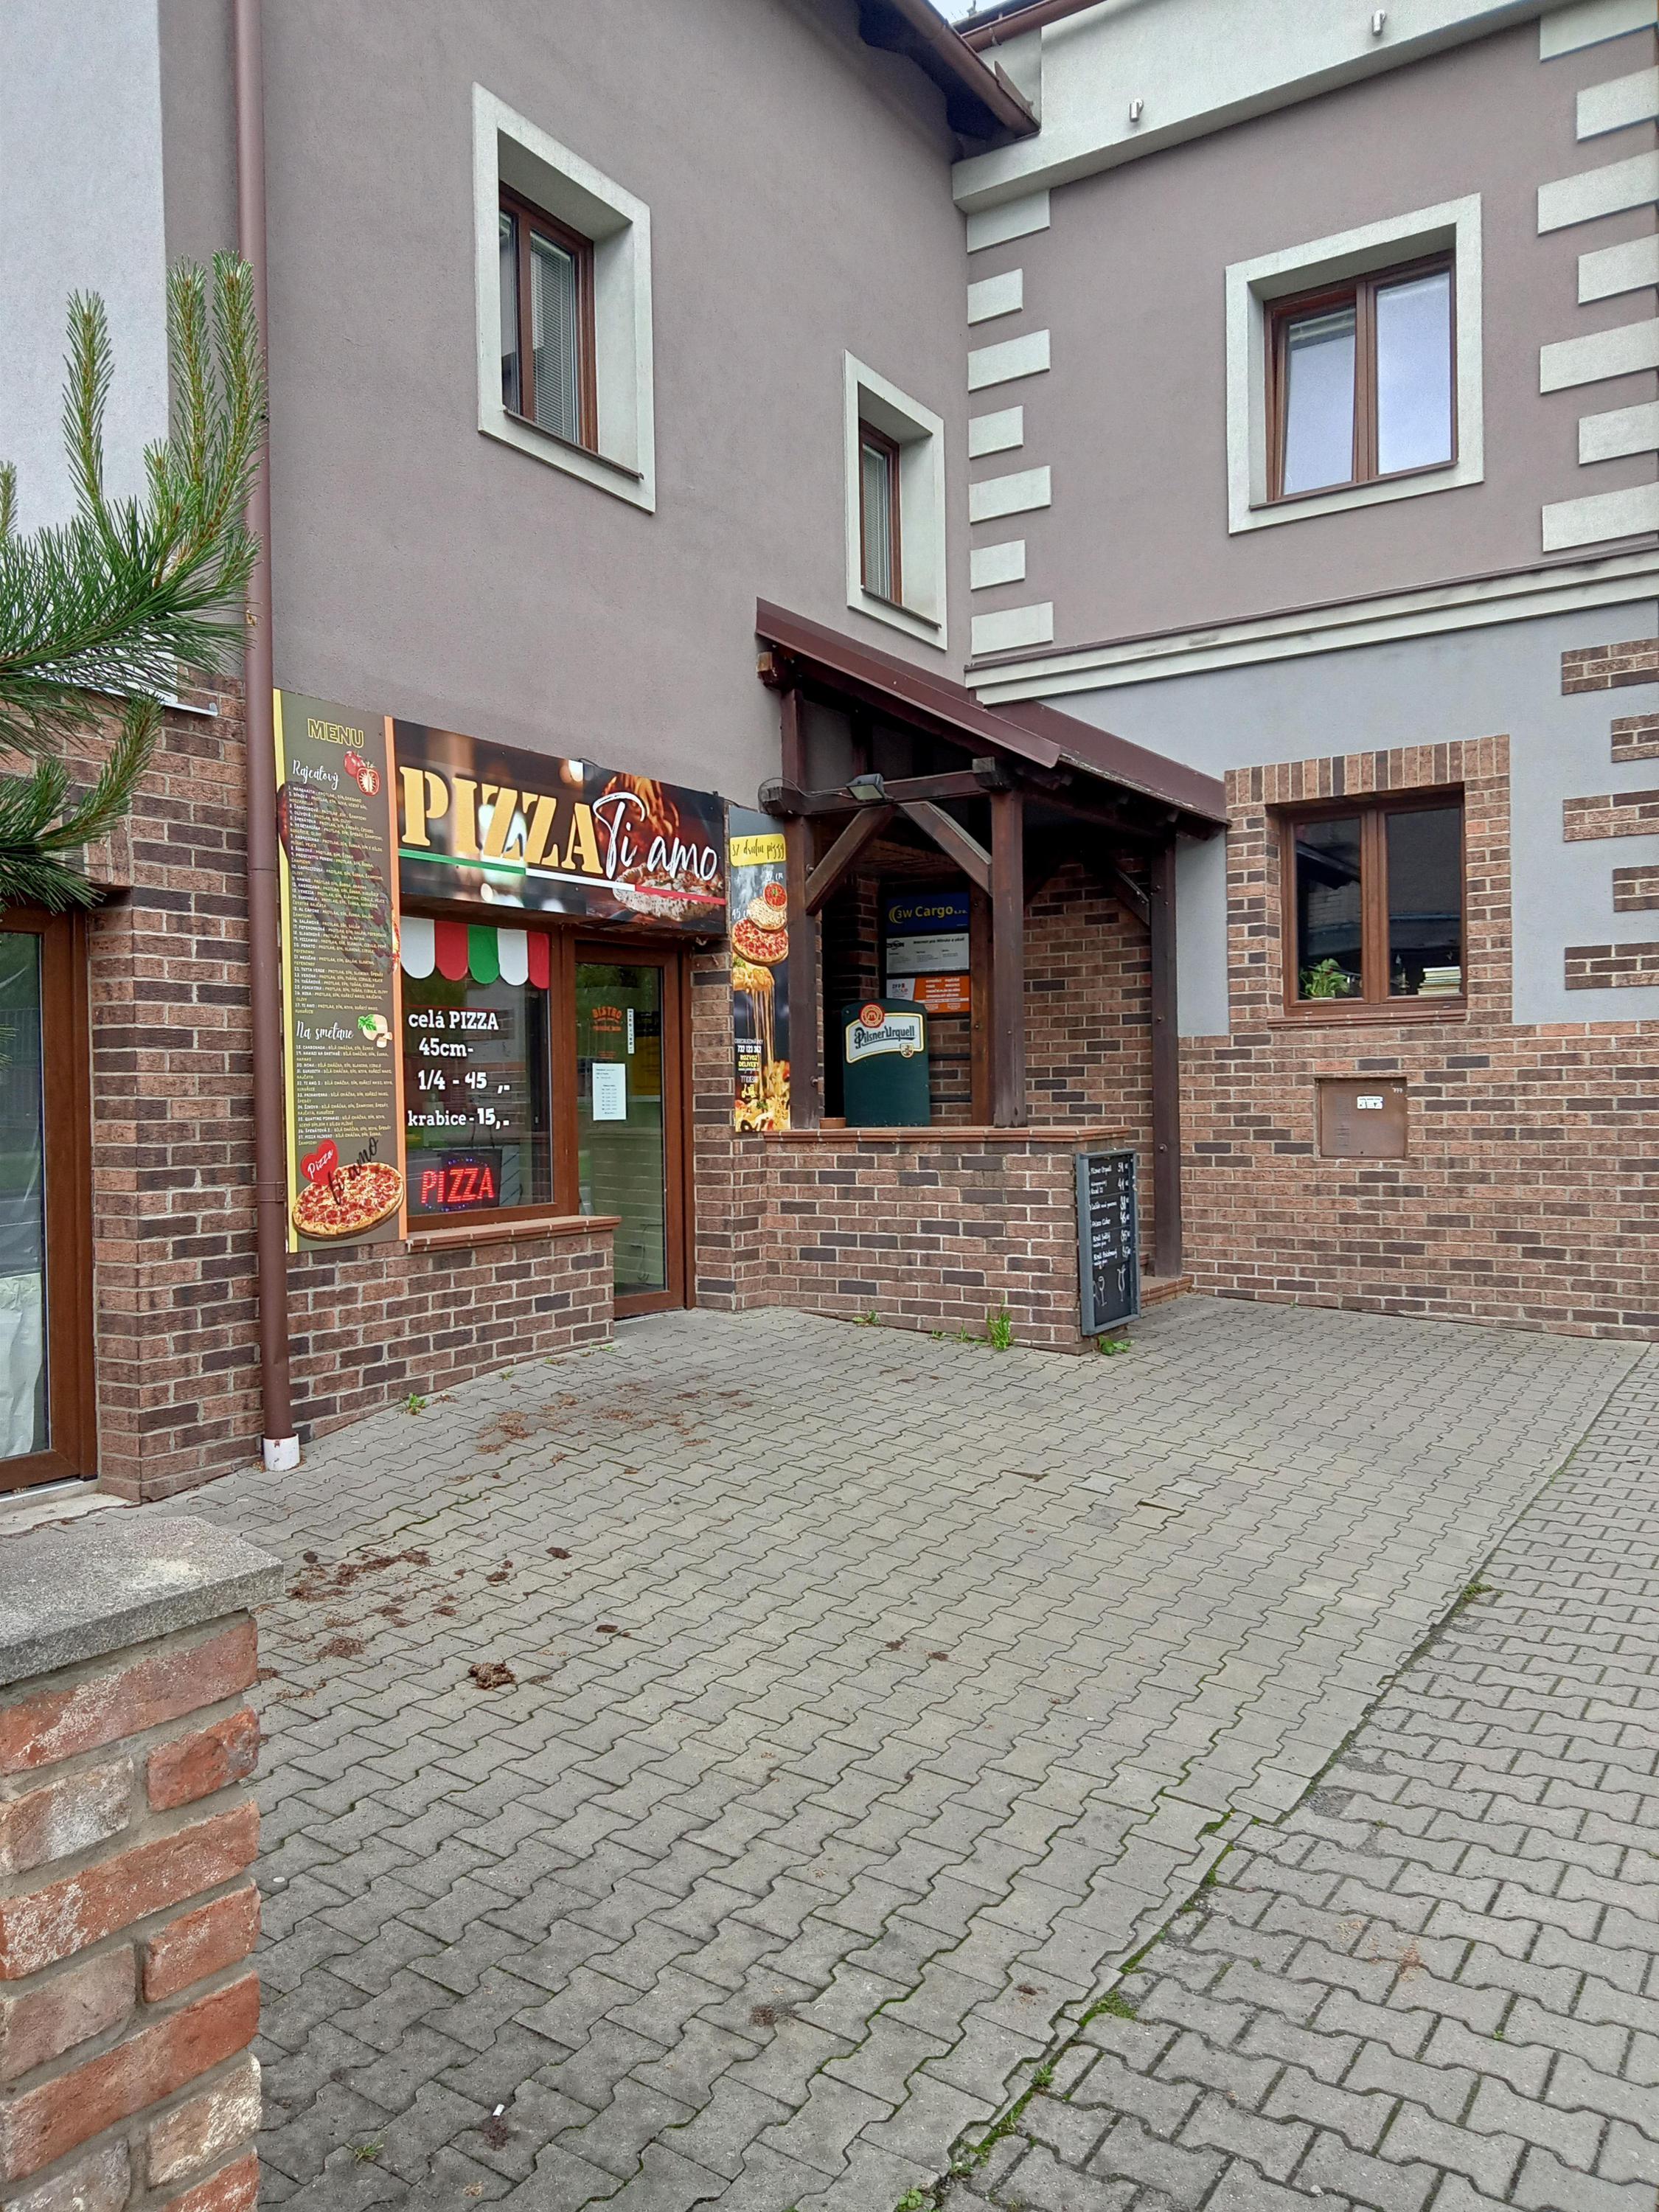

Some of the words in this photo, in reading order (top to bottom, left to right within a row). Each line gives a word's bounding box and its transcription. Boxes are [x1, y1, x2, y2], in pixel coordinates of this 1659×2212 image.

[307, 718, 364, 748] MENU
[399, 766, 604, 874] PIZZA
[593, 792, 646, 879] Ti
[647, 836, 717, 881] amo
[915, 906, 953, 918] Cargo
[408, 1009, 445, 1028] celá
[449, 1011, 499, 1030] PIZZA
[592, 1006, 623, 1019] BISTRO
[296, 1020, 311, 1040] Na
[854, 1027, 884, 1049] Pilsner
[884, 1026, 915, 1041] Urquell
[419, 1037, 473, 1057] 45cm-
[418, 1070, 446, 1090] 1/4
[408, 1110, 466, 1126] krabice
[477, 1107, 509, 1130] 15,-
[307, 1149, 333, 1179] Pizza
[348, 1137, 378, 1180] amo
[421, 1168, 495, 1203] PIZZA
